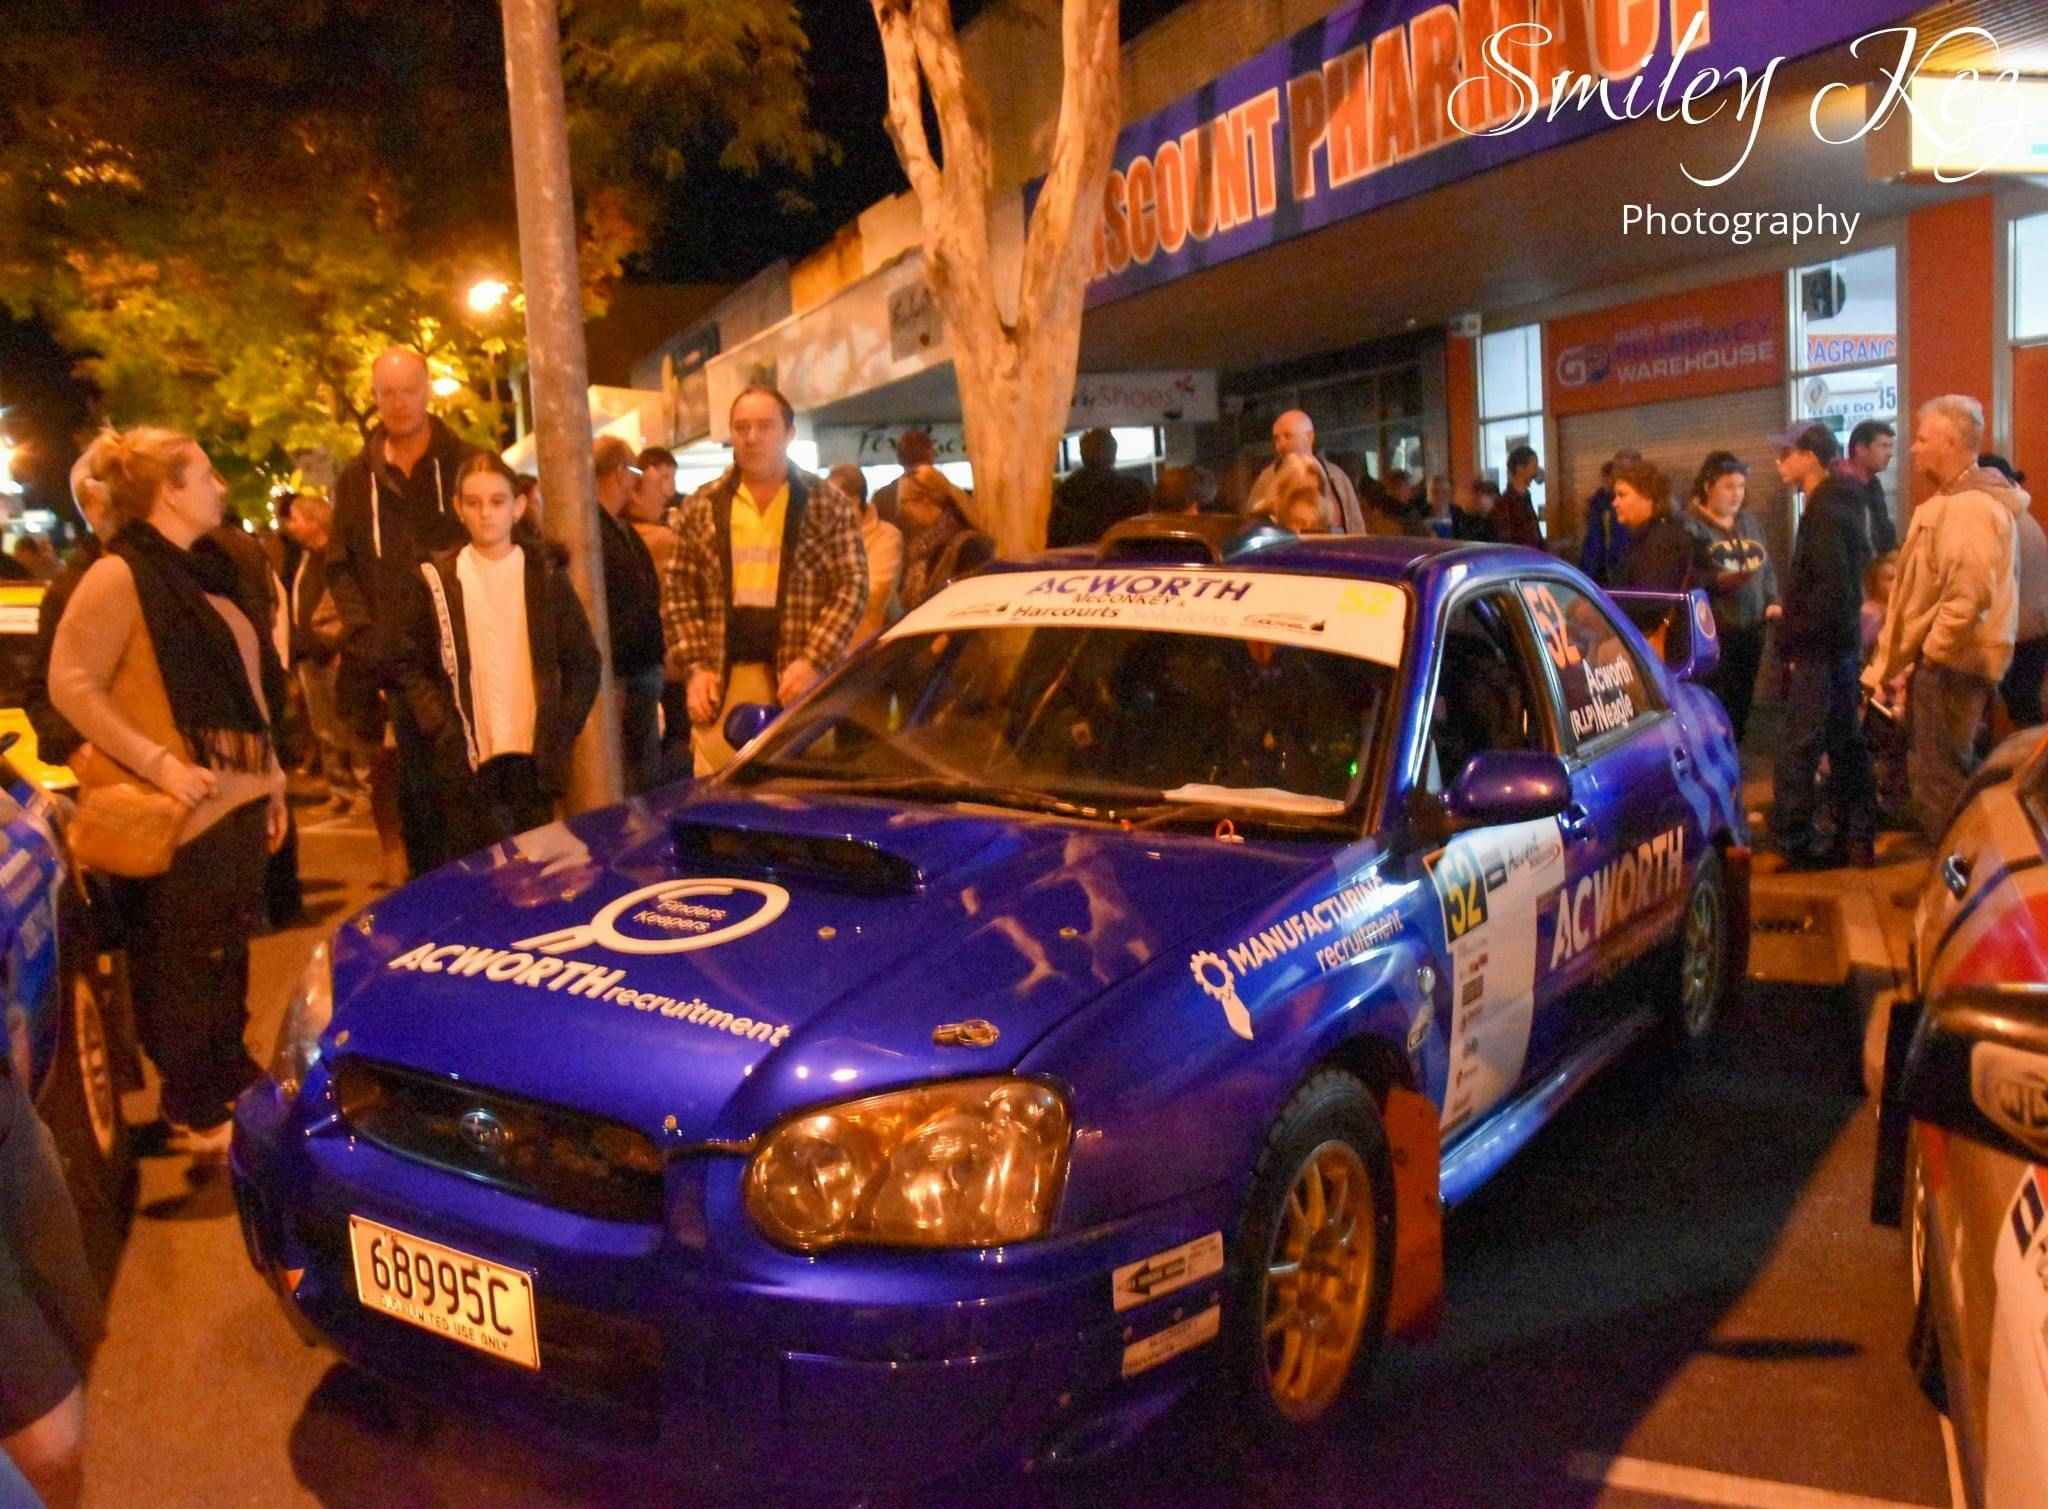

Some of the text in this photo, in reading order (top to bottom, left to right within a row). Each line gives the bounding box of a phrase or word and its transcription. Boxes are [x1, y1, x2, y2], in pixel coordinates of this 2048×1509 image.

[1092, 88, 1279, 279] ISCOUNT
[1617, 341, 1774, 384] WAREHOUSE
[1024, 574, 1254, 602] ACWORTH
[1338, 584, 1395, 618] 52
[1012, 605, 1121, 619] Harcourts
[1523, 584, 1581, 669] 52
[1582, 653, 1634, 696] Acworth
[657, 900, 726, 921] Finders
[1438, 849, 1484, 937] 52
[1551, 825, 1684, 969] ACWORTH
[633, 911, 710, 933] Keepers
[1315, 908, 1404, 973] recruitment
[388, 942, 791, 1047] ACWORTH recruitment
[370, 1237, 514, 1336] 68995C
[454, 1321, 475, 1341] USE
[481, 1331, 508, 1352] ONLY
